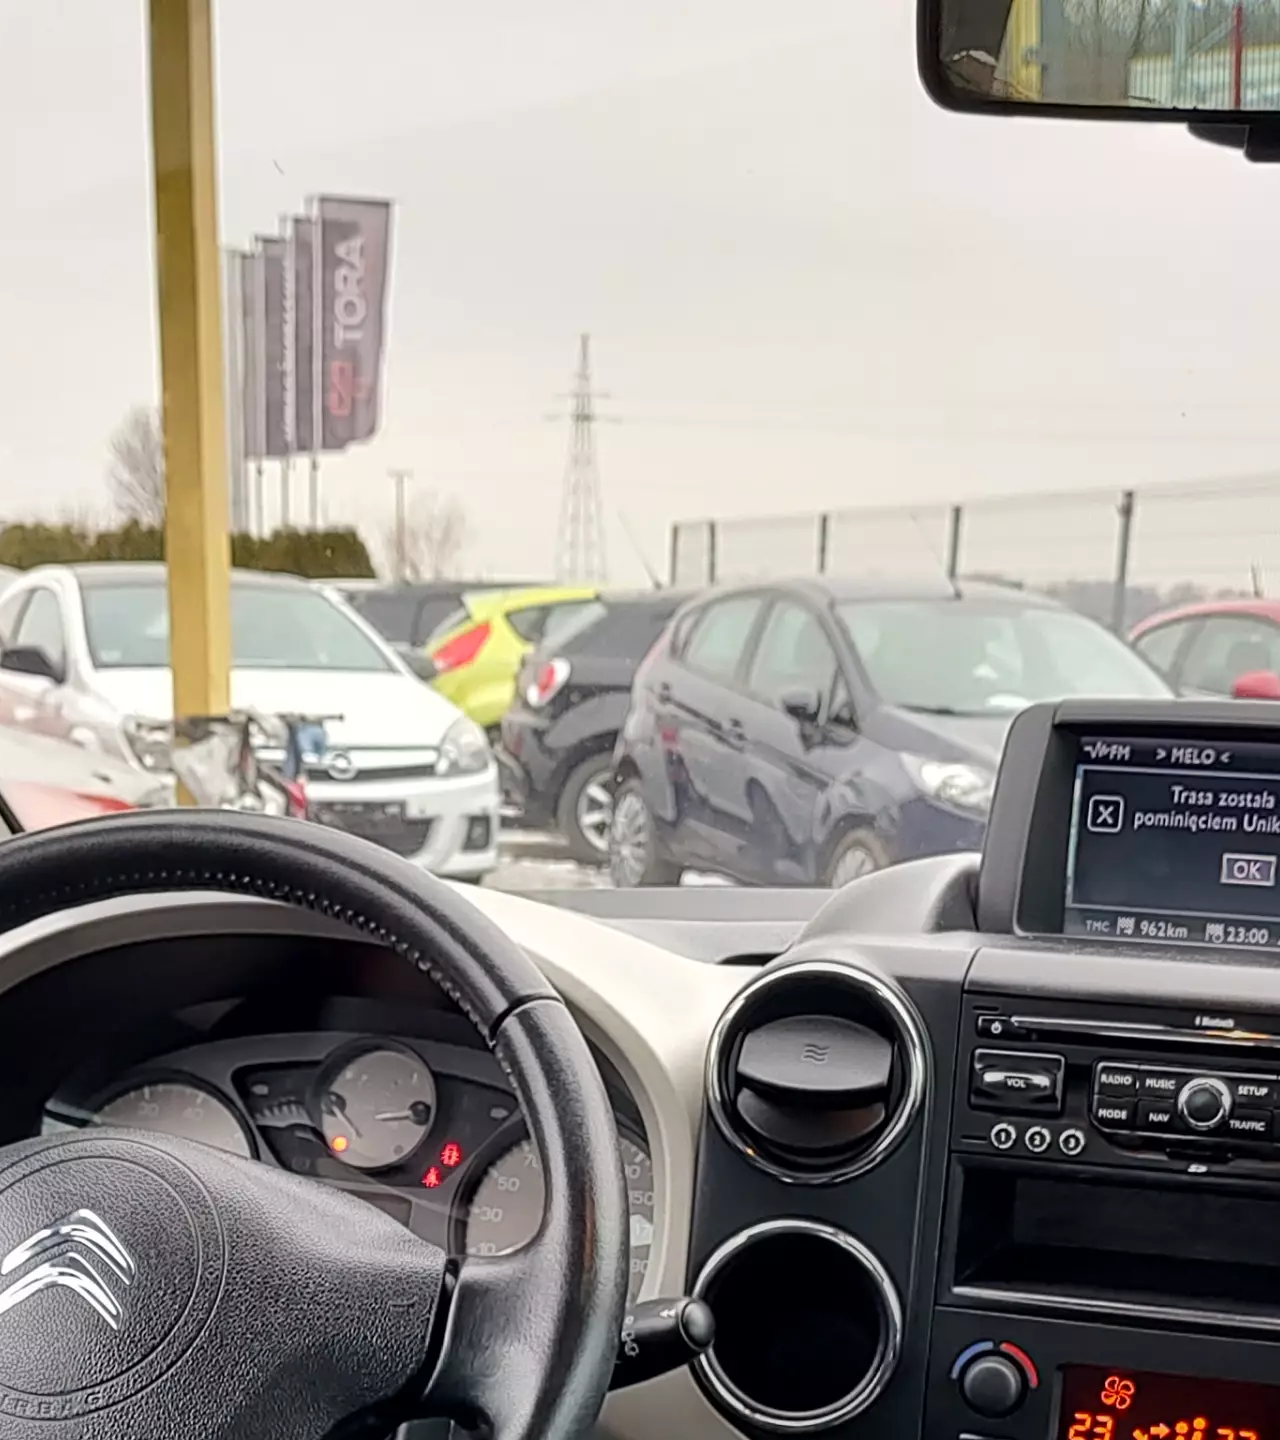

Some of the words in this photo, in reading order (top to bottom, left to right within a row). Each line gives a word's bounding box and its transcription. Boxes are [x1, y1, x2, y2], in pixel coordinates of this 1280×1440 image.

[333, 235, 368, 350] TORA
[1170, 746, 1217, 765] MELO
[1170, 784, 1213, 806] Trasa
[1231, 861, 1264, 881] OK
[1084, 919, 1110, 934] TMC
[1139, 919, 1188, 940] 962km
[1226, 926, 1270, 945] 23:00
[1005, 1077, 1027, 1089] VOL
[1100, 1072, 1133, 1086] RADIO
[1144, 1076, 1176, 1090] MUSIC
[1237, 1083, 1269, 1097] SETUP
[1097, 1106, 1128, 1121] MODE
[1148, 1110, 1170, 1124] NAV
[1228, 1118, 1266, 1132] TRAFFIC
[497, 1175, 520, 1193] 50
[479, 1205, 504, 1223] 30
